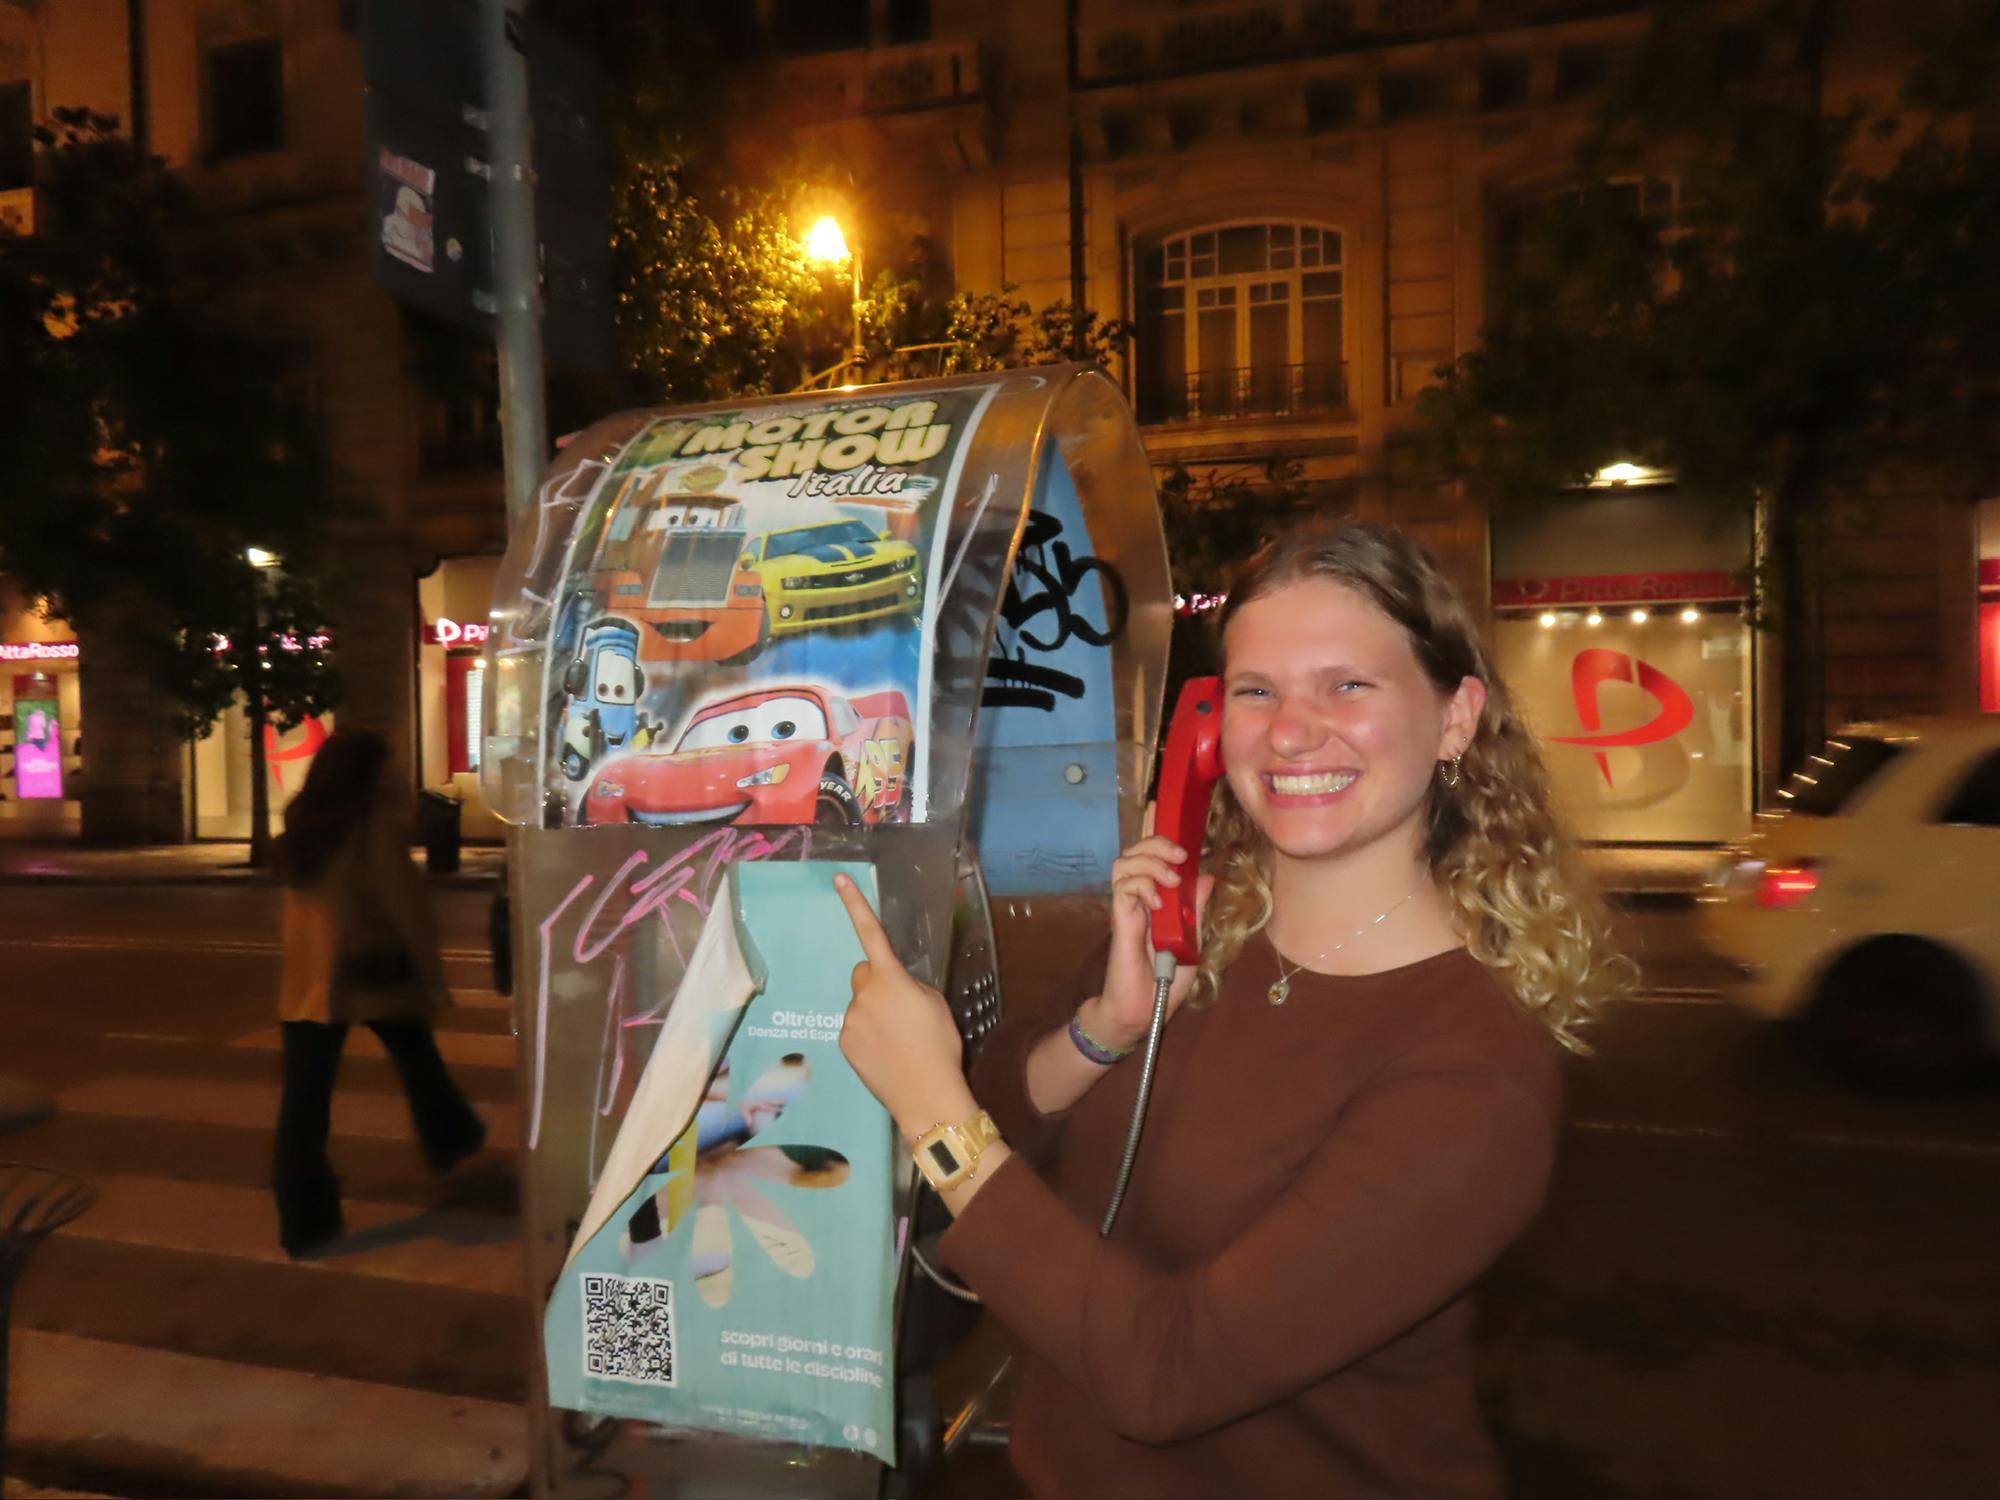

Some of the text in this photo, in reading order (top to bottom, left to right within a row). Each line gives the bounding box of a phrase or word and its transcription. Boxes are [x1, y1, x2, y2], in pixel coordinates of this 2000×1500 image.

[681, 400, 939, 456] MOTOR
[735, 423, 952, 481] SHOW
[786, 465, 910, 498] Italia
[0, 642, 79, 659] ittaRosso
[747, 1025, 840, 1043] Danza ed Espr
[771, 1010, 845, 1028] Oltrétoil
[720, 1330, 774, 1348] scopri
[777, 1334, 828, 1353] giorni
[830, 1342, 843, 1357] e
[720, 1350, 884, 1388] di tutte le discipline
